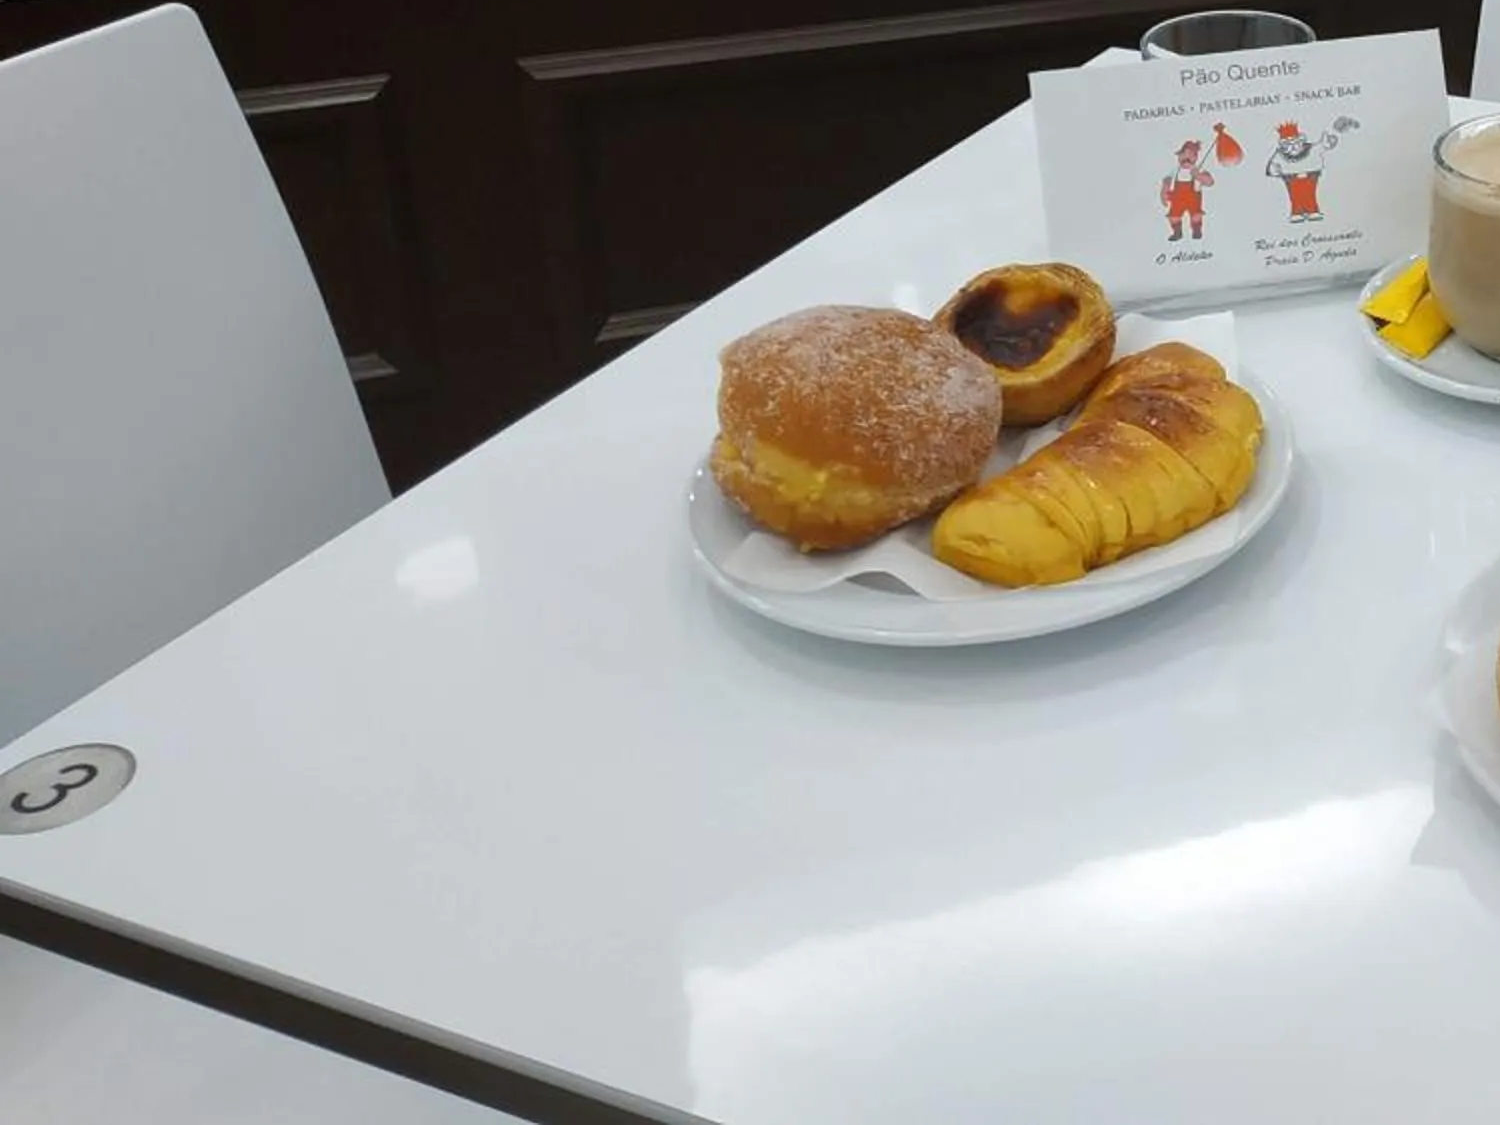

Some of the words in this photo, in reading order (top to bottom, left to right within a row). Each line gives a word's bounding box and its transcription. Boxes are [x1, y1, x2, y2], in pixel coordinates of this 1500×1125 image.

[1179, 68, 1221, 87] Pão
[1227, 60, 1301, 80] Quente
[1124, 104, 1186, 121] PADARIAS
[1199, 94, 1281, 114] PASTELARIAS
[1294, 87, 1334, 102] SNACK
[1337, 84, 1361, 97] BAR
[9, 762, 98, 814] 3
